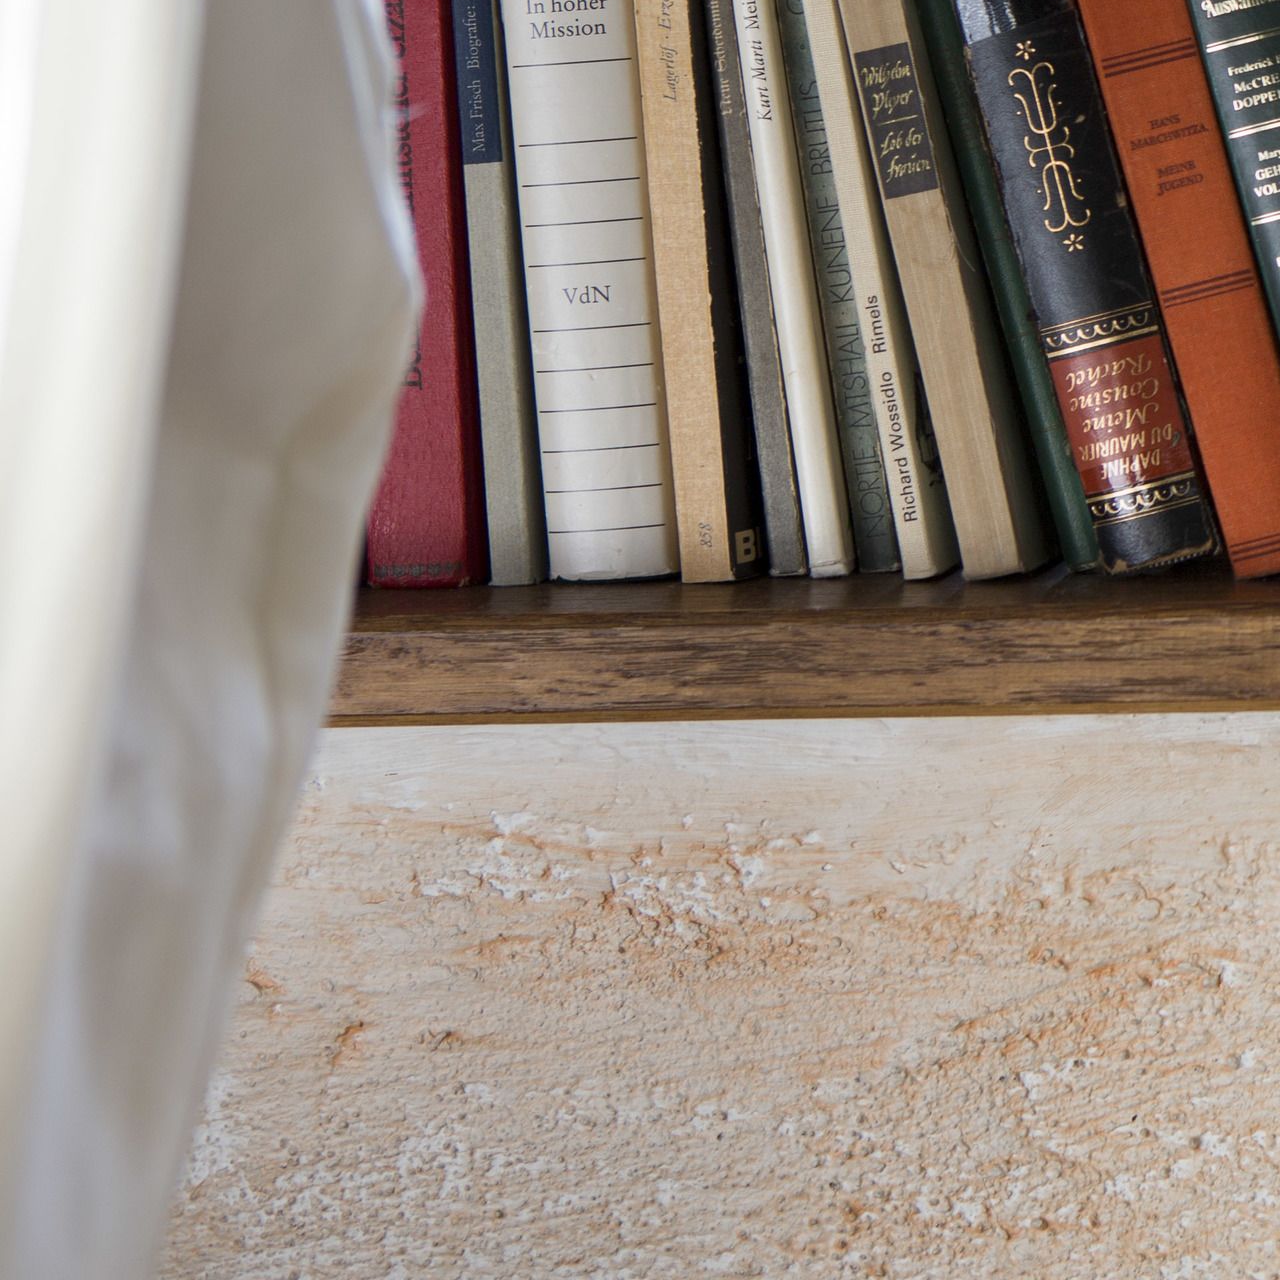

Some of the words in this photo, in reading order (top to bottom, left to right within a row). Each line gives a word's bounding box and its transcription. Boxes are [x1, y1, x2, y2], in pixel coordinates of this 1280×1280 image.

[465, 5, 482, 70] Biografie:
[530, 19, 607, 39] Mission
[663, 44, 681, 102] Lagerlöf
[751, 40, 766, 81] Marti
[861, 60, 911, 88] Wilhelm
[1228, 58, 1274, 76] Frederick
[467, 79, 486, 122] Frisch
[757, 80, 772, 121] Kurt
[472, 123, 488, 152] Max
[1149, 114, 1181, 130] HANS
[880, 130, 903, 158] Lob
[904, 128, 924, 148] der
[1158, 160, 1196, 178] MEINE
[1157, 174, 1204, 196] JUGEND
[816, 197, 855, 304] KUNENE
[562, 285, 611, 304] VdN
[866, 295, 888, 354] Rimels
[1065, 353, 1152, 392] Rachel
[1070, 378, 1159, 412] Cousine
[880, 370, 905, 453] Wossidlo
[1082, 402, 1159, 433] Meine
[1078, 431, 1146, 462] MAURIER
[1151, 423, 1173, 445] DU
[1101, 449, 1160, 480] DAPHNE
[895, 457, 918, 522] Richard
